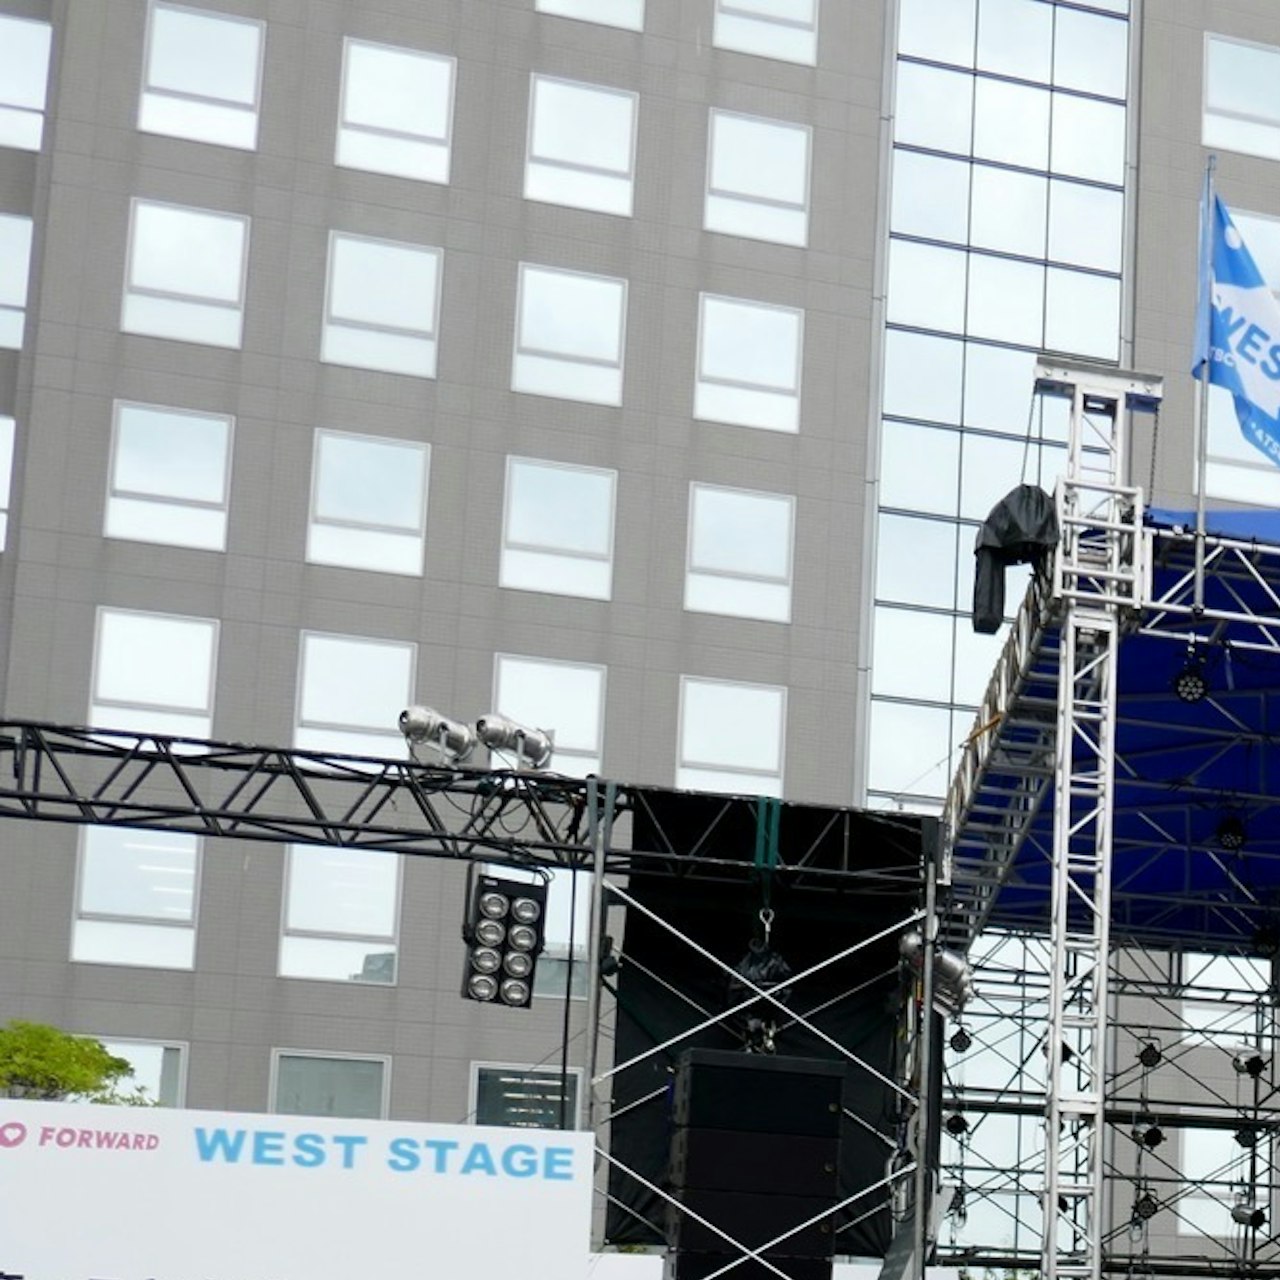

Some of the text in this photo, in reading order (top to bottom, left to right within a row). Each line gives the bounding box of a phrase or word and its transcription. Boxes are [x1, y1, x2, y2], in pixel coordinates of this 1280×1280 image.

[38, 1126, 160, 1151] FORWARD
[194, 1127, 574, 1181] WEST STAGE
